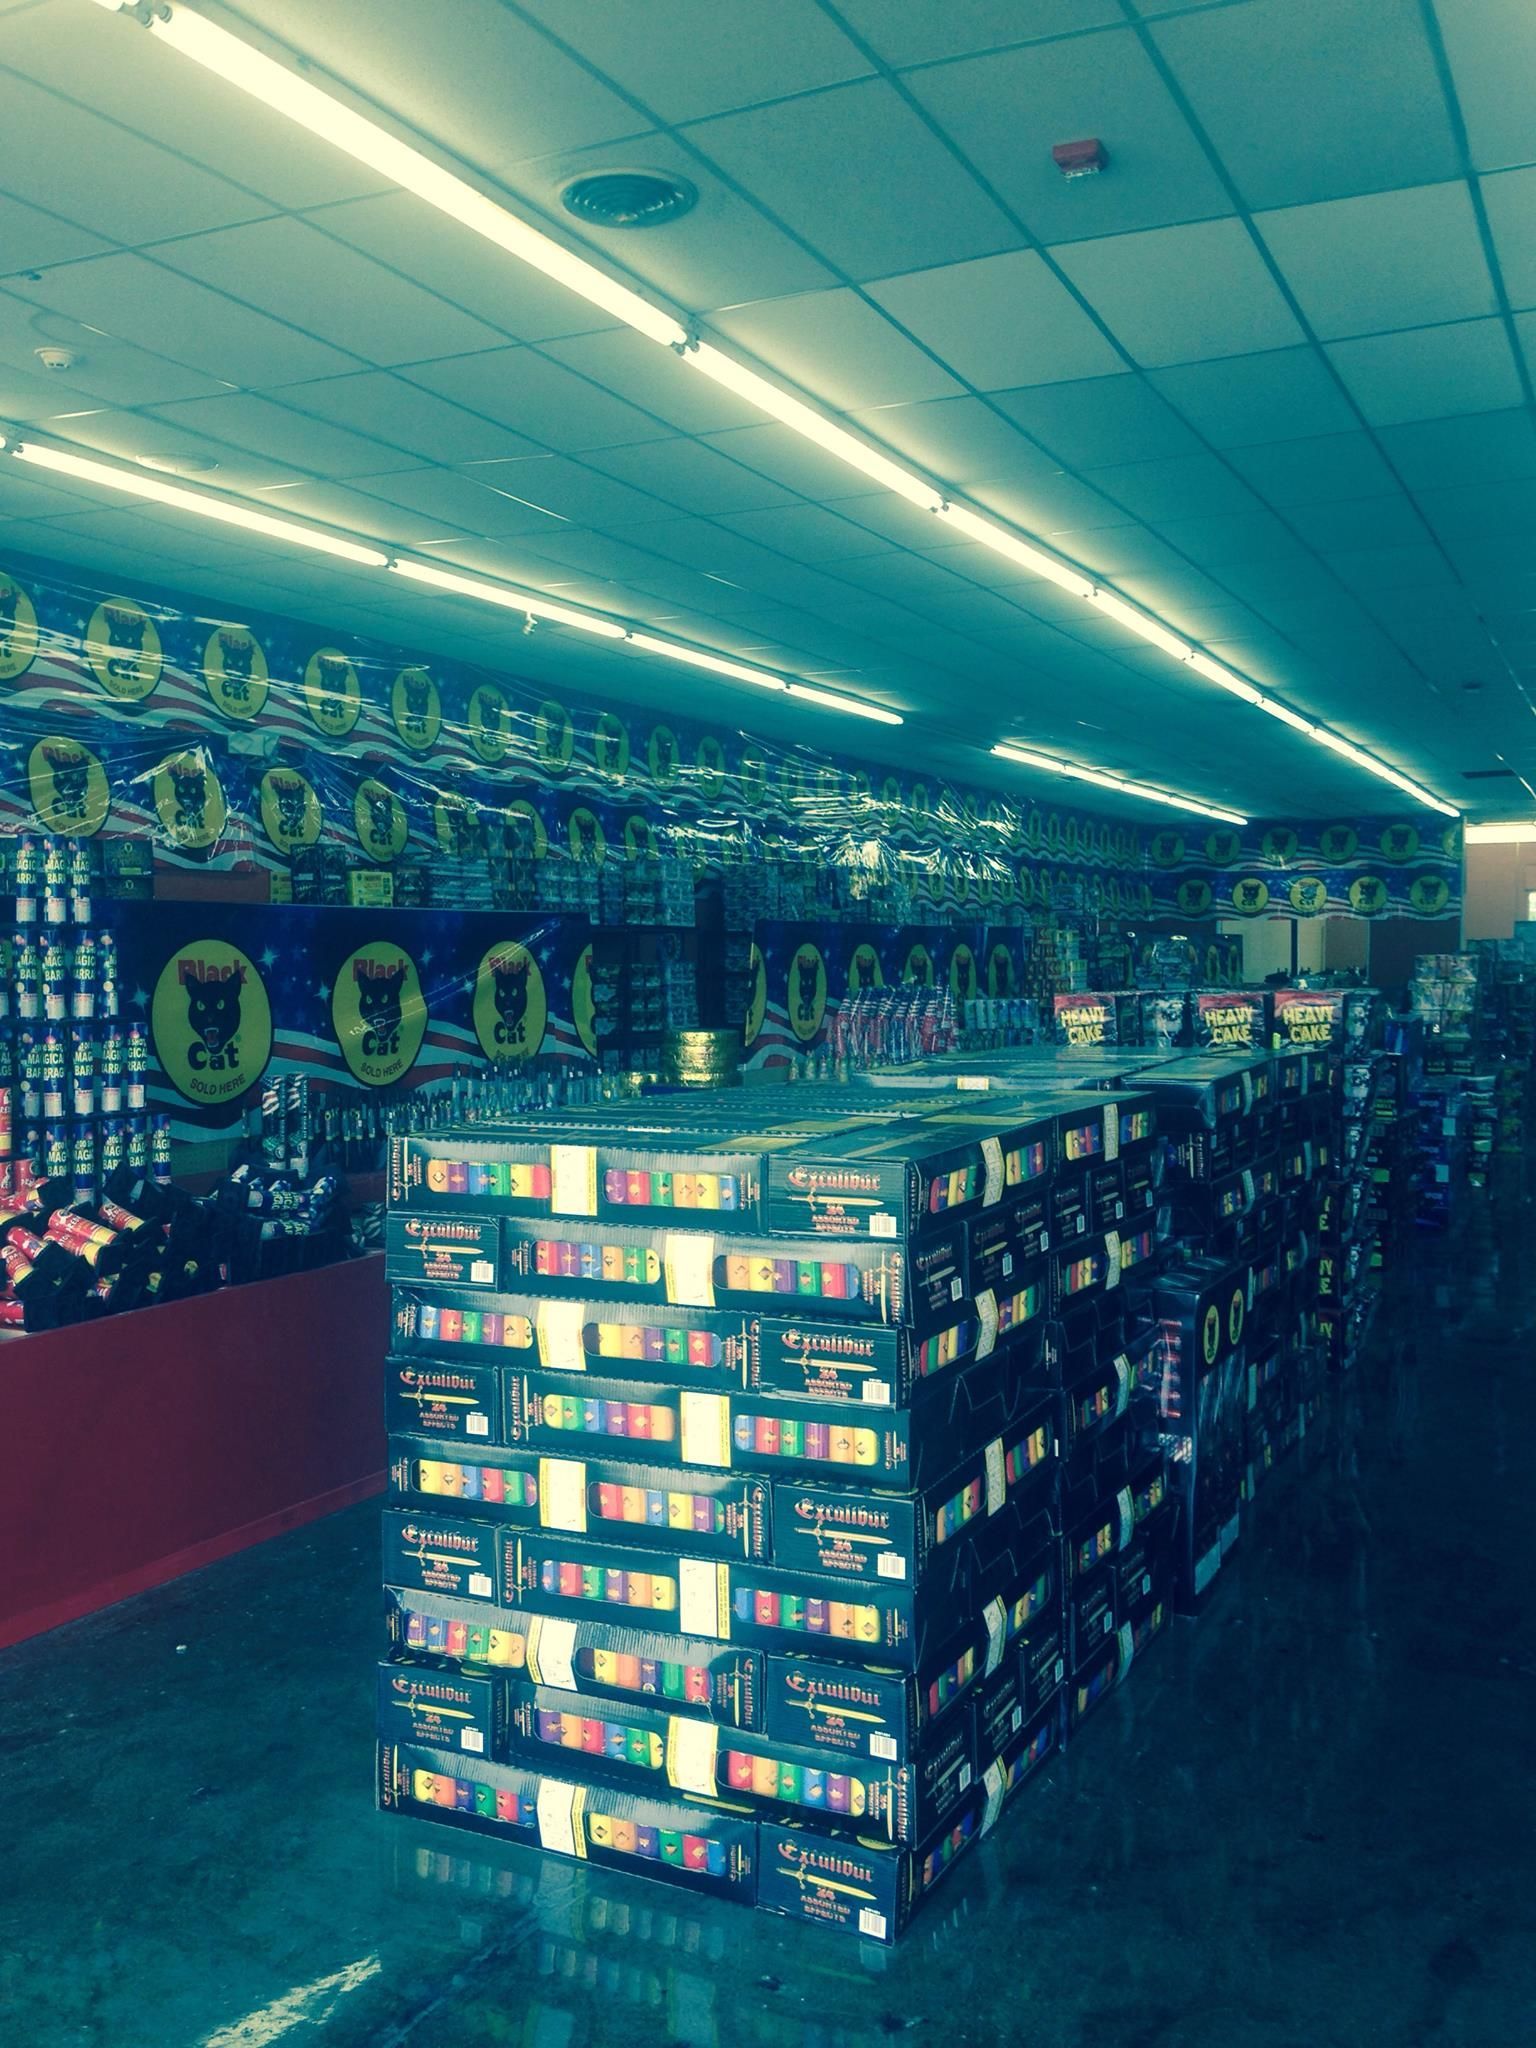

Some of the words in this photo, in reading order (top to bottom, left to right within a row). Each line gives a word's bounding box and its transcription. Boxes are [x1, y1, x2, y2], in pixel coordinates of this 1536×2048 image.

[221, 680, 249, 702] Cat
[52, 797, 87, 819] Cat
[174, 810, 205, 830] Cat
[278, 819, 304, 838] Cat
[369, 828, 393, 846] Cat
[177, 959, 248, 986] Black
[352, 958, 409, 983] Black
[488, 956, 532, 978] Black
[1061, 1006, 1106, 1027] HEAVY
[1204, 1006, 1253, 1027] HEAVY
[1282, 1005, 1334, 1026] HEAVY
[361, 1031, 399, 1056] Cat
[494, 1021, 526, 1045] Cat
[1067, 1023, 1105, 1044] CAKE
[1211, 1024, 1252, 1044] CAKE
[1289, 1024, 1332, 1043] CAKE
[187, 1041, 239, 1071] Cat
[360, 1062, 381, 1078] SOLD
[382, 1060, 403, 1078] HERE
[190, 1077, 216, 1096] SOLD
[216, 1073, 247, 1096] HERE
[788, 1166, 880, 1191] Excalibur
[405, 1218, 481, 1240] Excalibur
[781, 1328, 874, 1356] Excalibur
[400, 1366, 476, 1390] Excalibur
[794, 1498, 889, 1529] Excalibur
[402, 1524, 479, 1552] Excalibur
[392, 1674, 472, 1704] Excalibur
[785, 1670, 881, 1706] Excalibur
[777, 1839, 874, 1883] Excalibur
